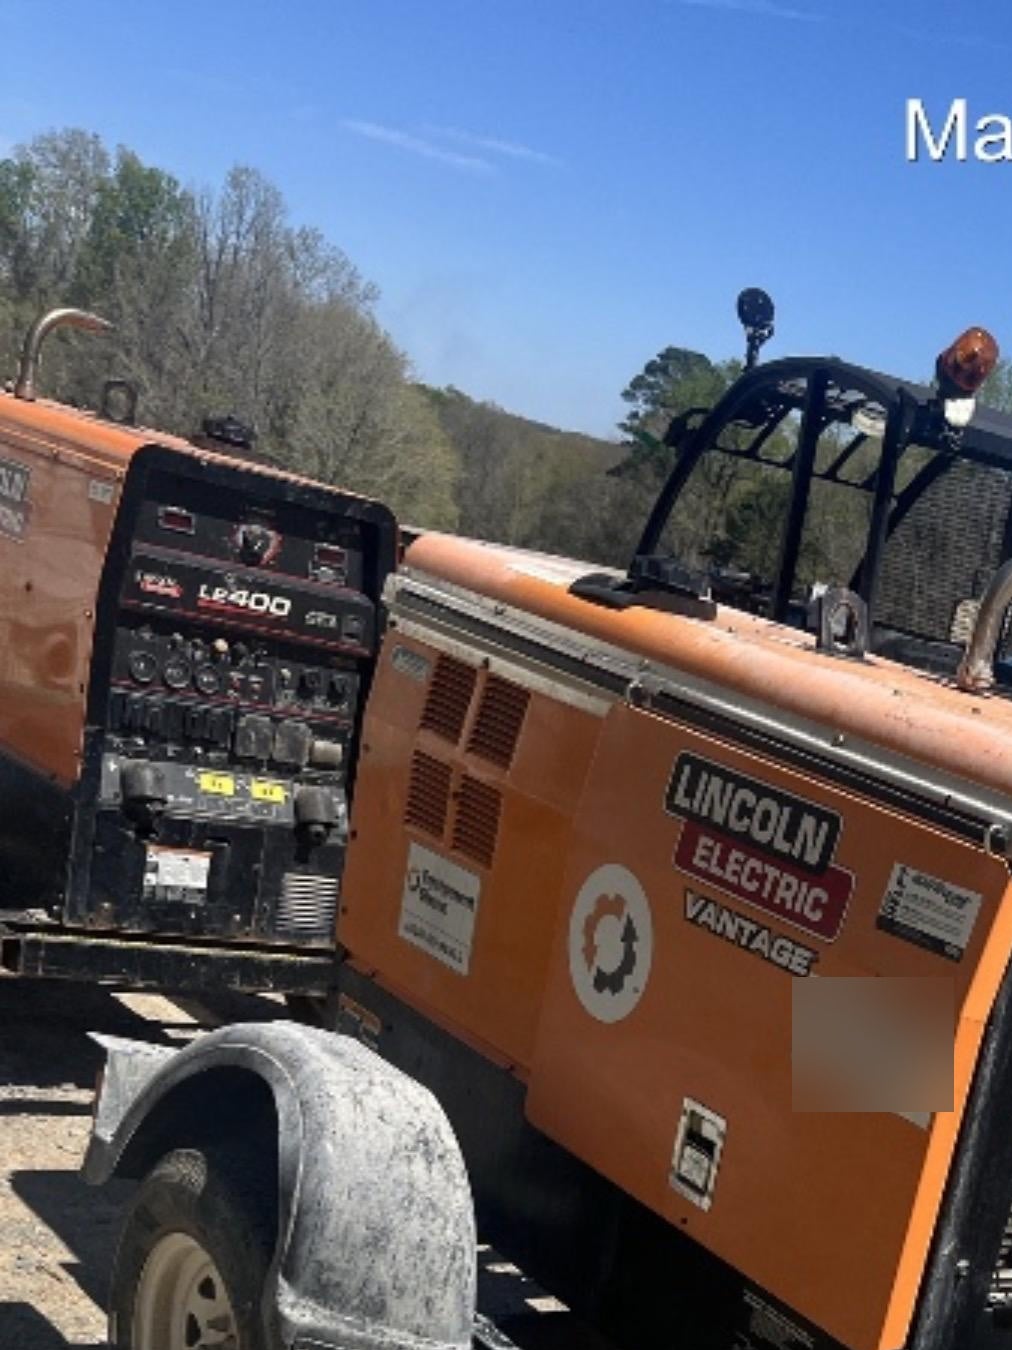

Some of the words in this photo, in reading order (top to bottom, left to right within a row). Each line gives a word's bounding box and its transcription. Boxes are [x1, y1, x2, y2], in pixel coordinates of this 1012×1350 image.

[674, 764, 830, 866] LINCOLN
[691, 835, 829, 922] ELECTRIC
[684, 891, 816, 977] VANTAGE
